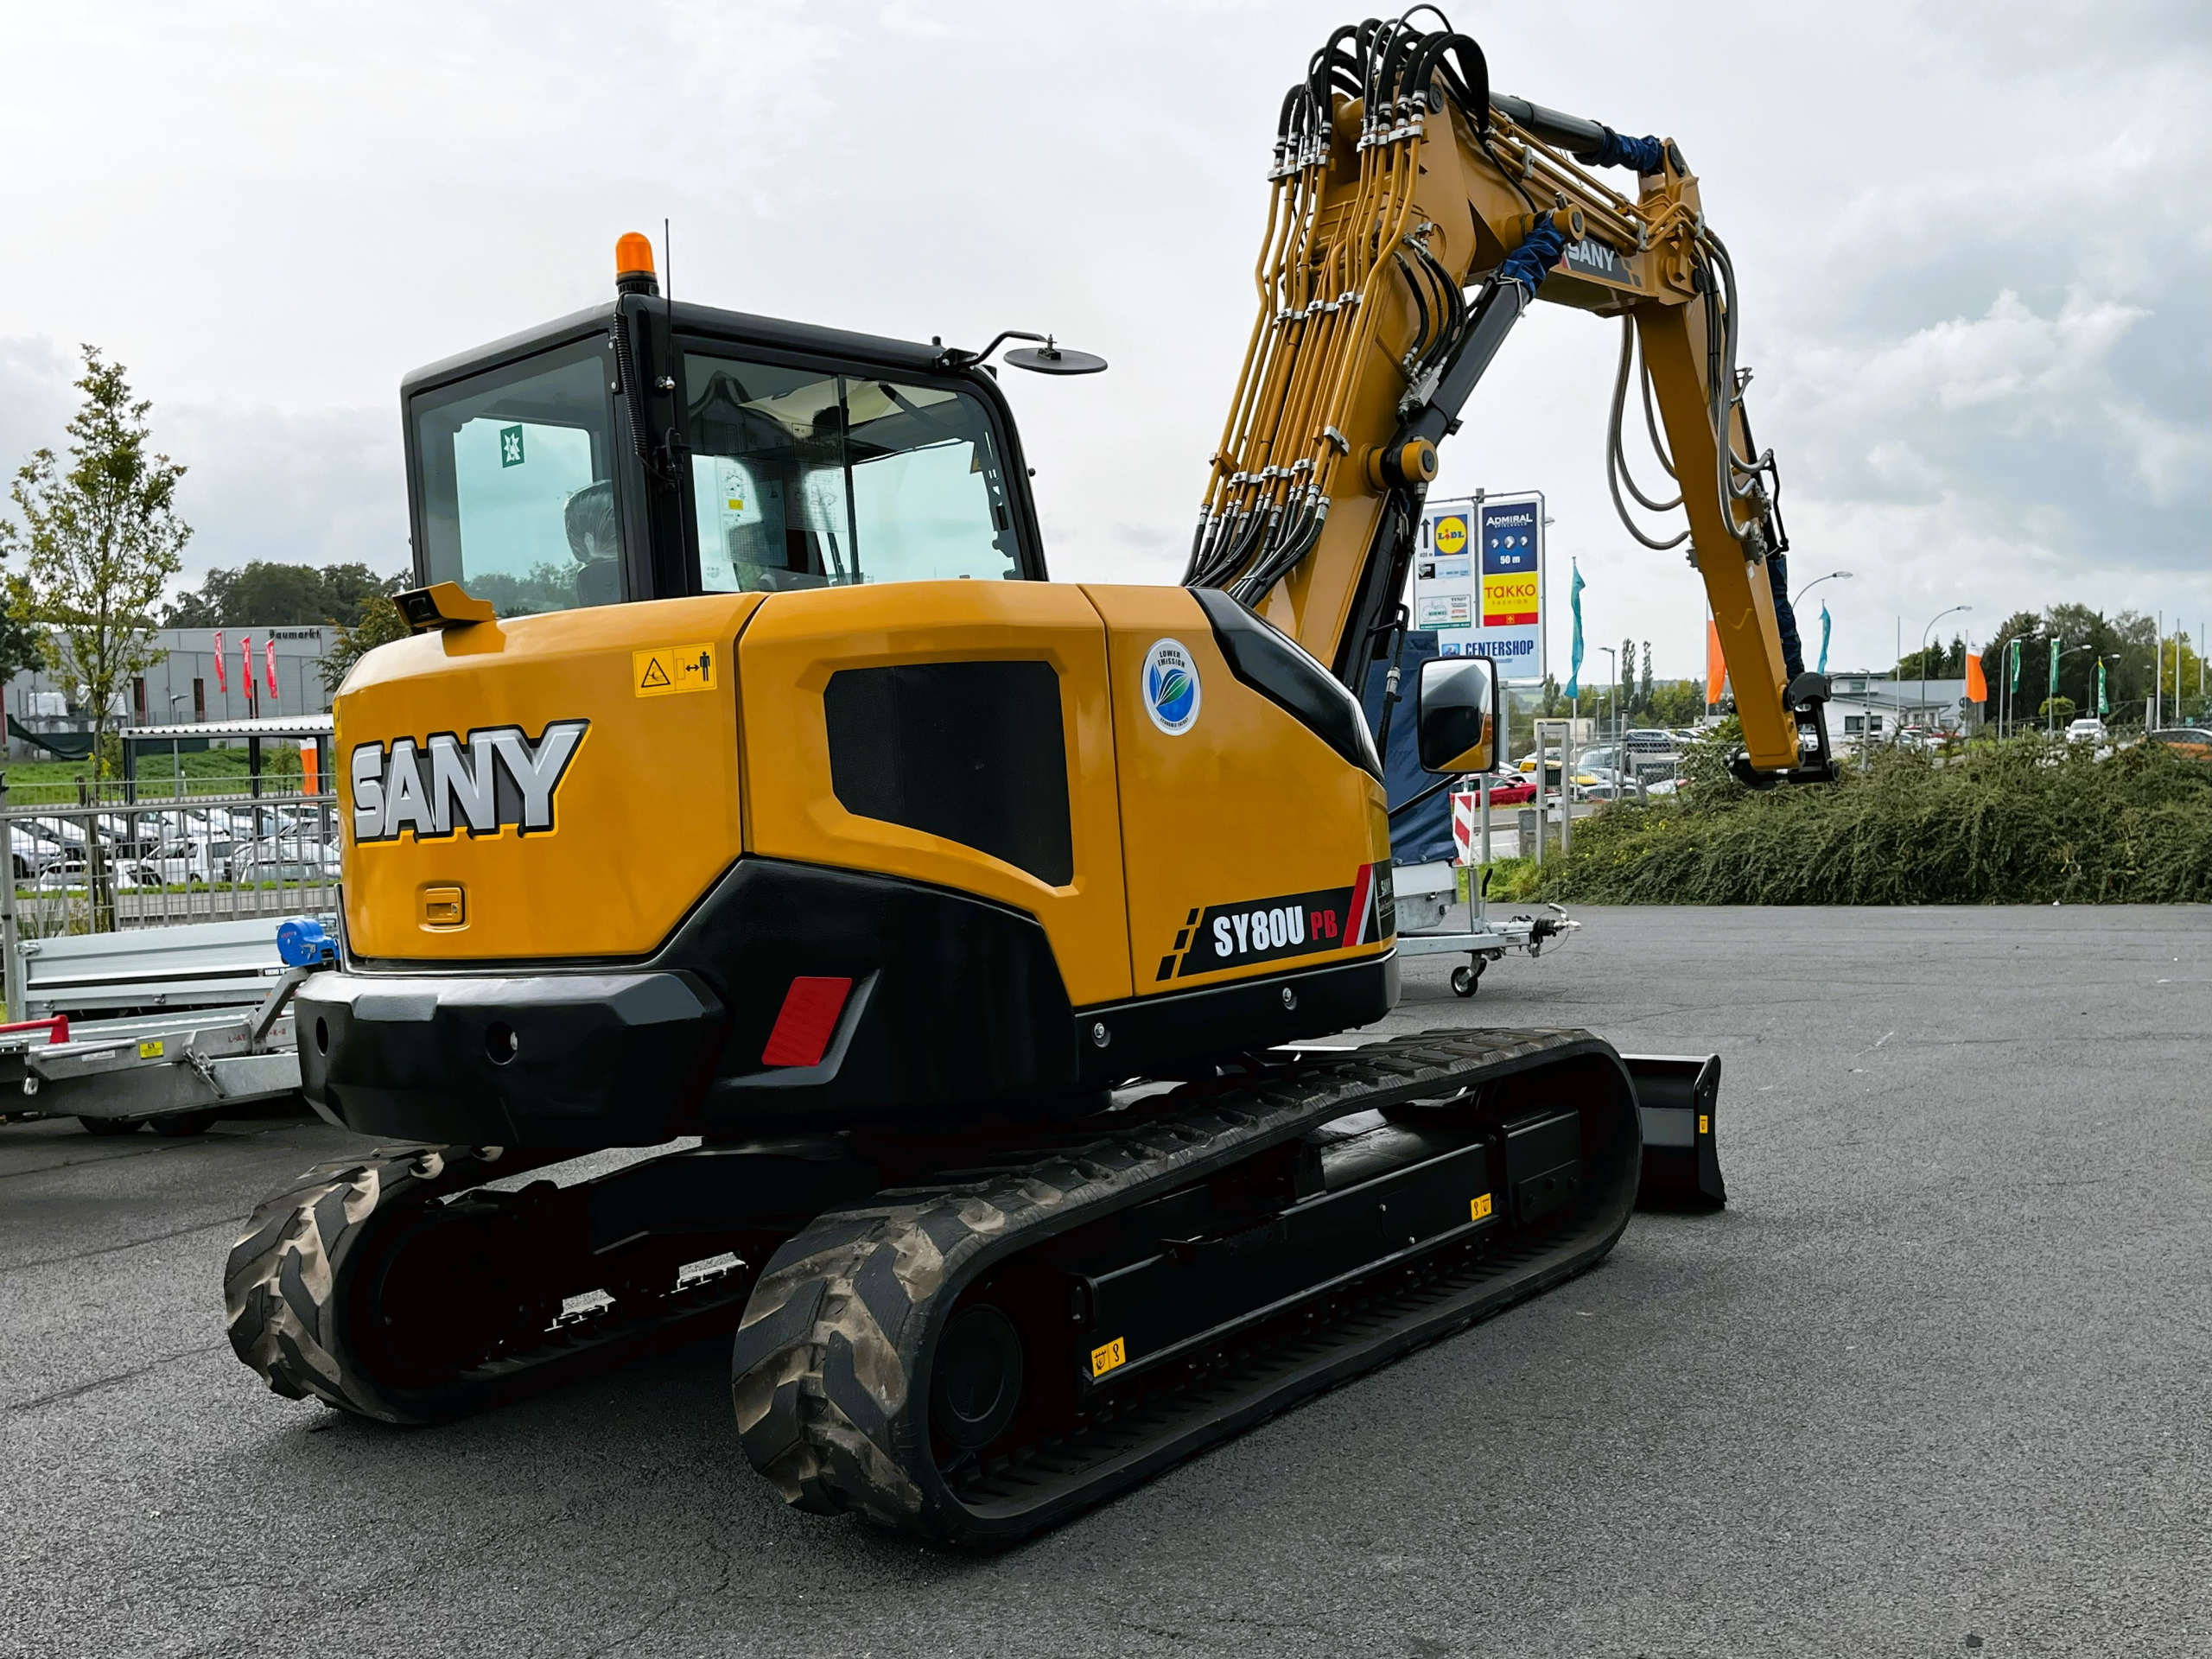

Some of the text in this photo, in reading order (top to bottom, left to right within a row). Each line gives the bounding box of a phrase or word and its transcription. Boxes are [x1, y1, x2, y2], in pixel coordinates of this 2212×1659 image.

[1567, 240, 1615, 272] SANY
[1486, 513, 1533, 526] ADMIRAL
[1500, 555, 1510, 564] 50
[269, 628, 321, 639] Baumarkt
[1159, 650, 1180, 658] LOWER
[1465, 640, 1534, 656] CENTERSHOP
[1158, 658, 1185, 668] EMISSION
[352, 720, 591, 843] SANY
[1213, 906, 1338, 957] SY80U PB
